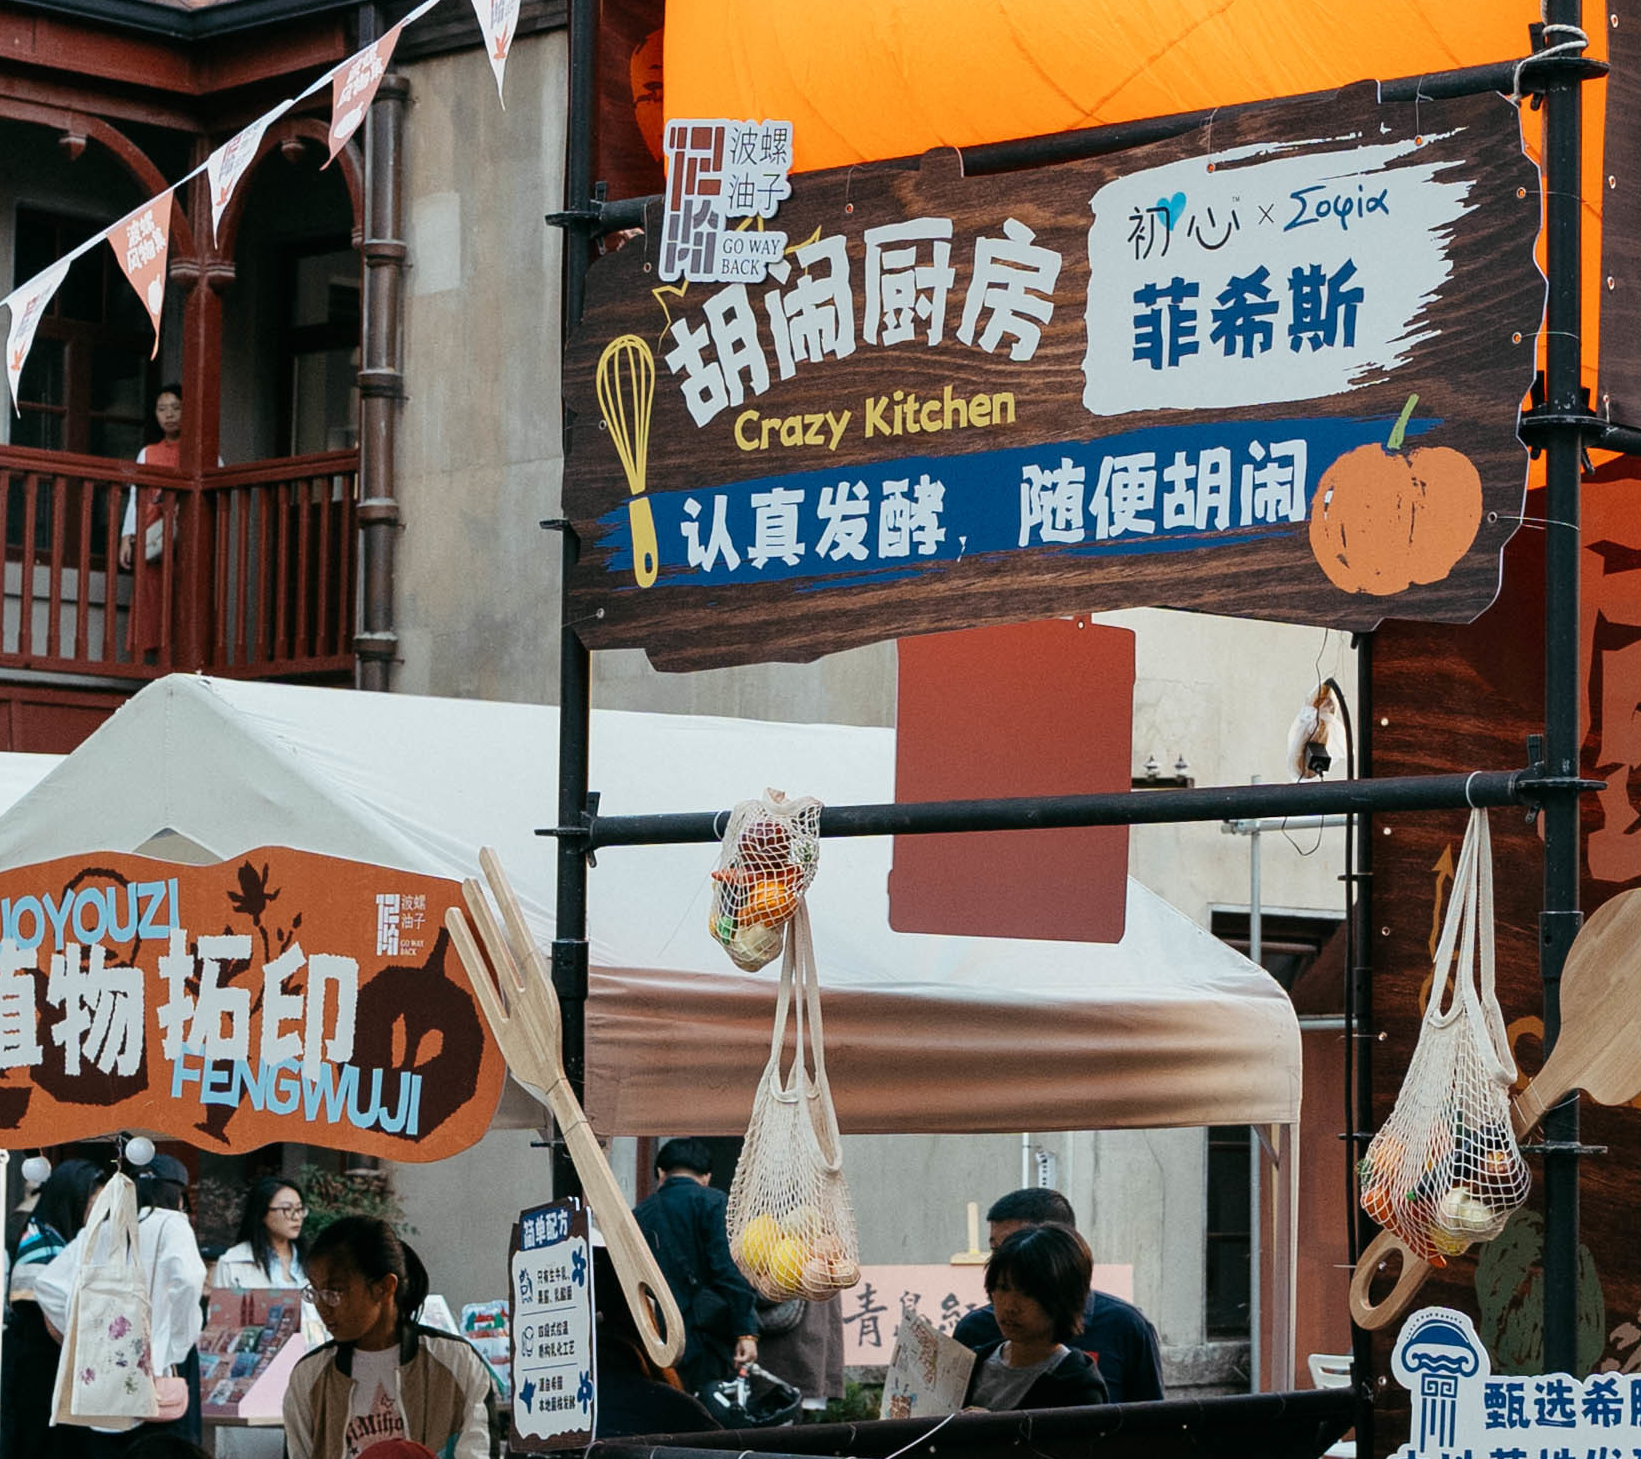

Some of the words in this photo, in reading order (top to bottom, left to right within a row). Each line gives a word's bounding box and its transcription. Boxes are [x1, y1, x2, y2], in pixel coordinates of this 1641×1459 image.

[730, 126, 787, 165] 波螺
[728, 173, 784, 210] 油子
[723, 238, 743, 254] GO
[750, 239, 780, 255] WAY
[1127, 198, 1241, 261] 初心
[722, 259, 759, 275] BACK
[666, 217, 1062, 427] 胡闹厨房
[1133, 258, 1365, 371] 菲希斯
[735, 403, 851, 453] Crazy
[865, 386, 1016, 441] Kitchen
[1017, 439, 1308, 547] 随便胡闹
[523, 1209, 568, 1248] 简单配方
